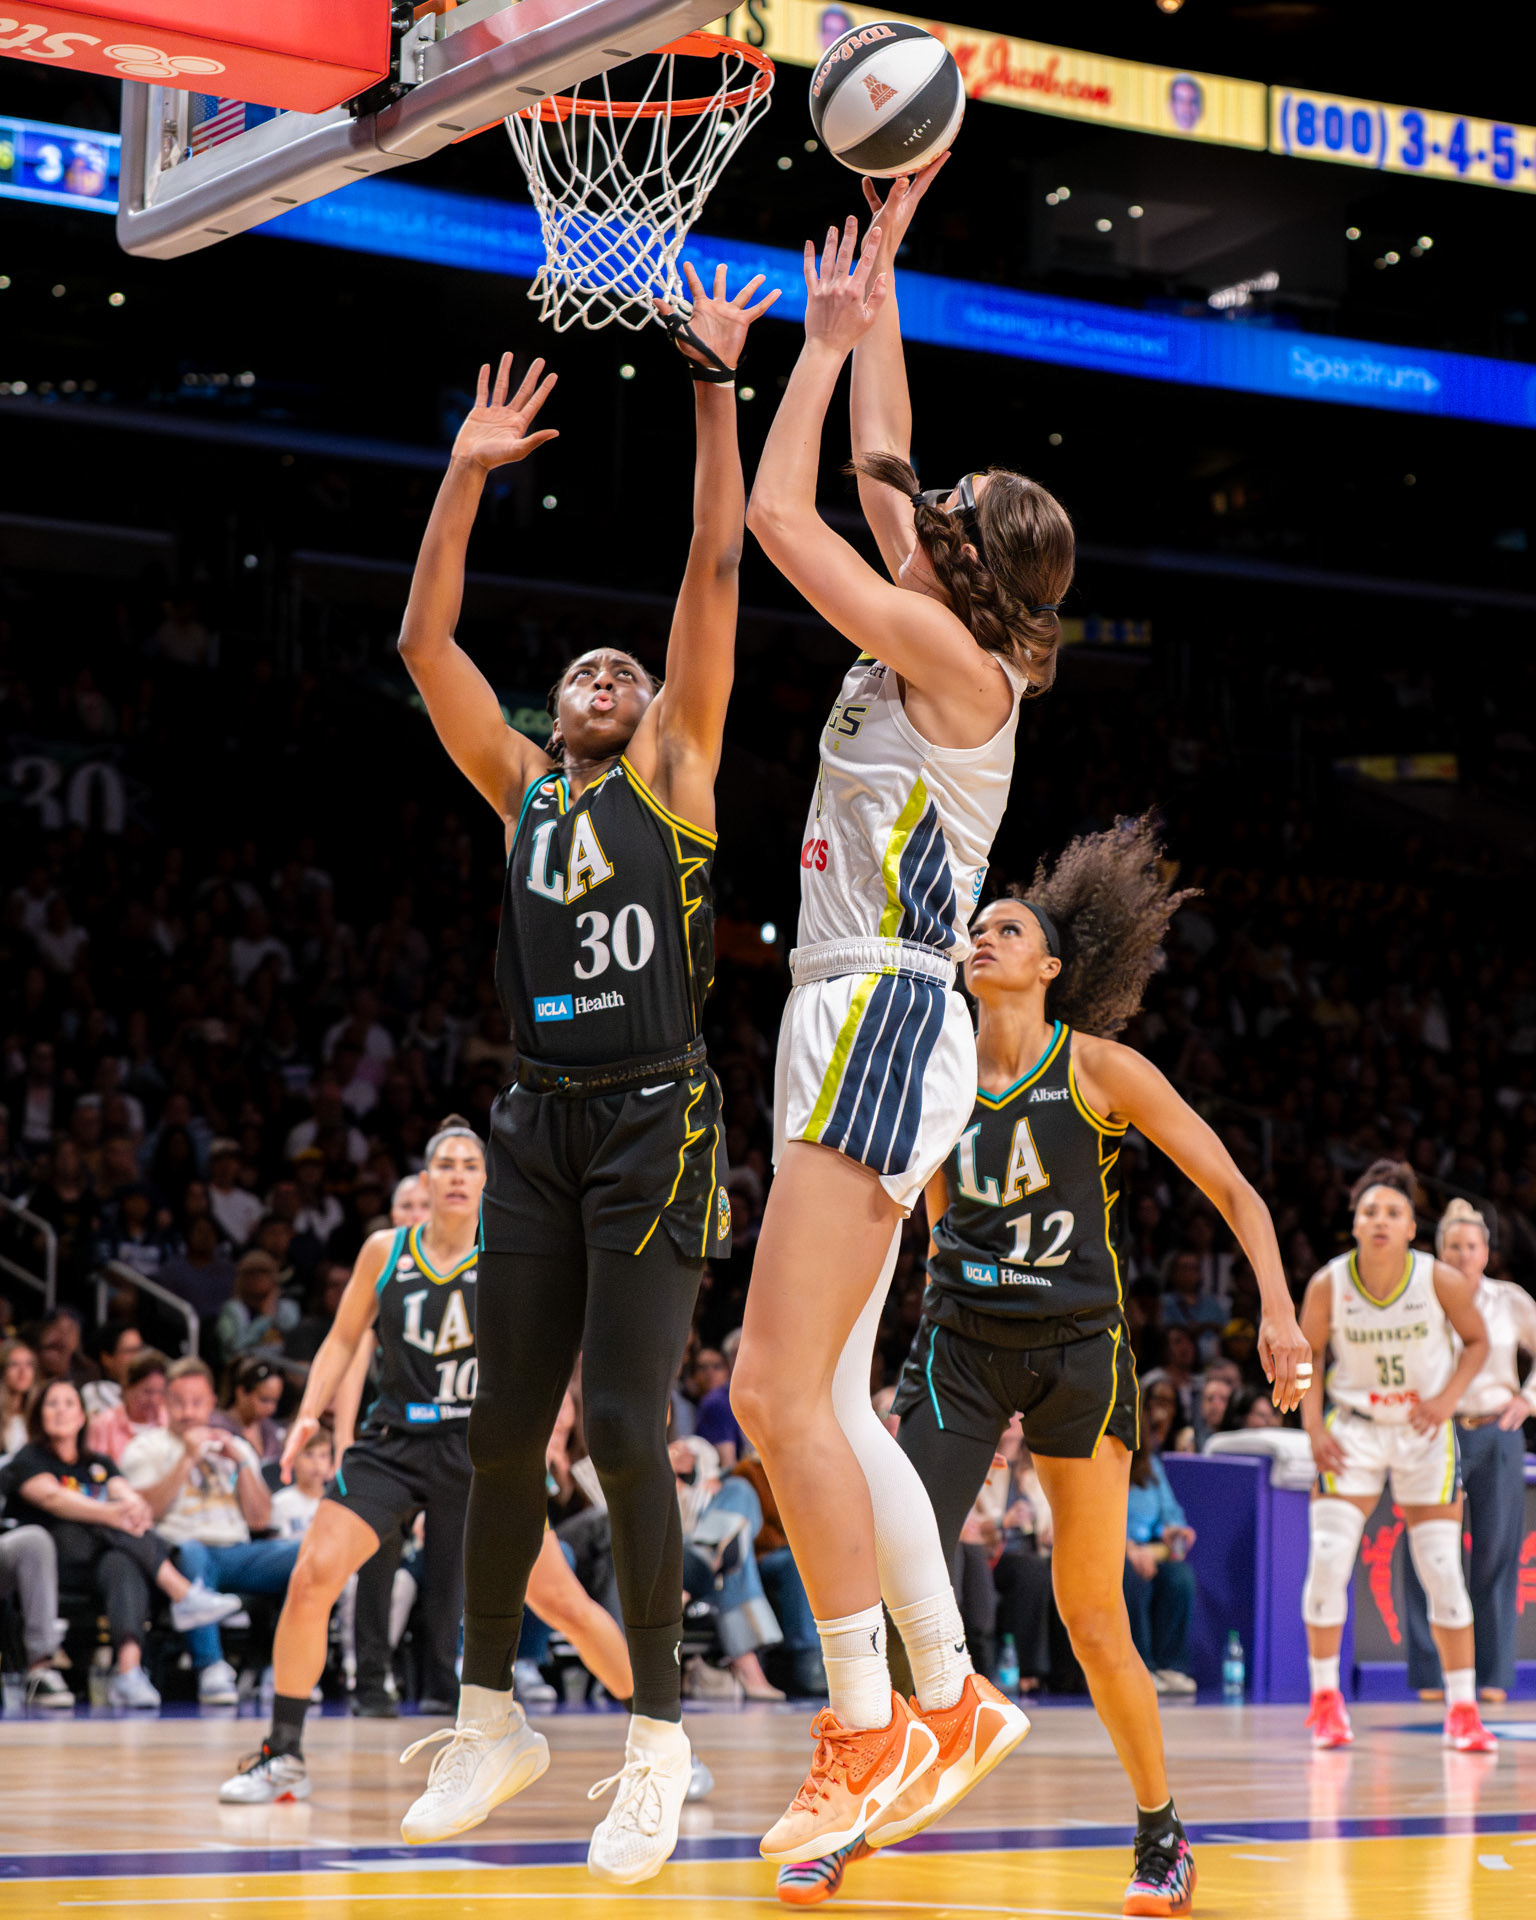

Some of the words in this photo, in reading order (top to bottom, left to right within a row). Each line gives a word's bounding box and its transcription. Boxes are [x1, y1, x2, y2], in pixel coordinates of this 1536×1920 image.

[812, 25, 897, 98] Wilson
[1280, 93, 1389, 170] (800)
[36, 144, 63, 183] 3
[527, 810, 615, 906] LA
[573, 903, 655, 980] 30
[538, 1001, 567, 1017] UCLA
[575, 991, 625, 1015] Health
[1029, 1087, 1070, 1103] Albert
[955, 1116, 1050, 1208] LA
[1000, 1209, 1075, 1267] 12
[966, 1265, 993, 1283] UCLA
[402, 1289, 475, 1357] LA
[433, 1357, 478, 1404] 10
[1375, 1353, 1405, 1387] 35
